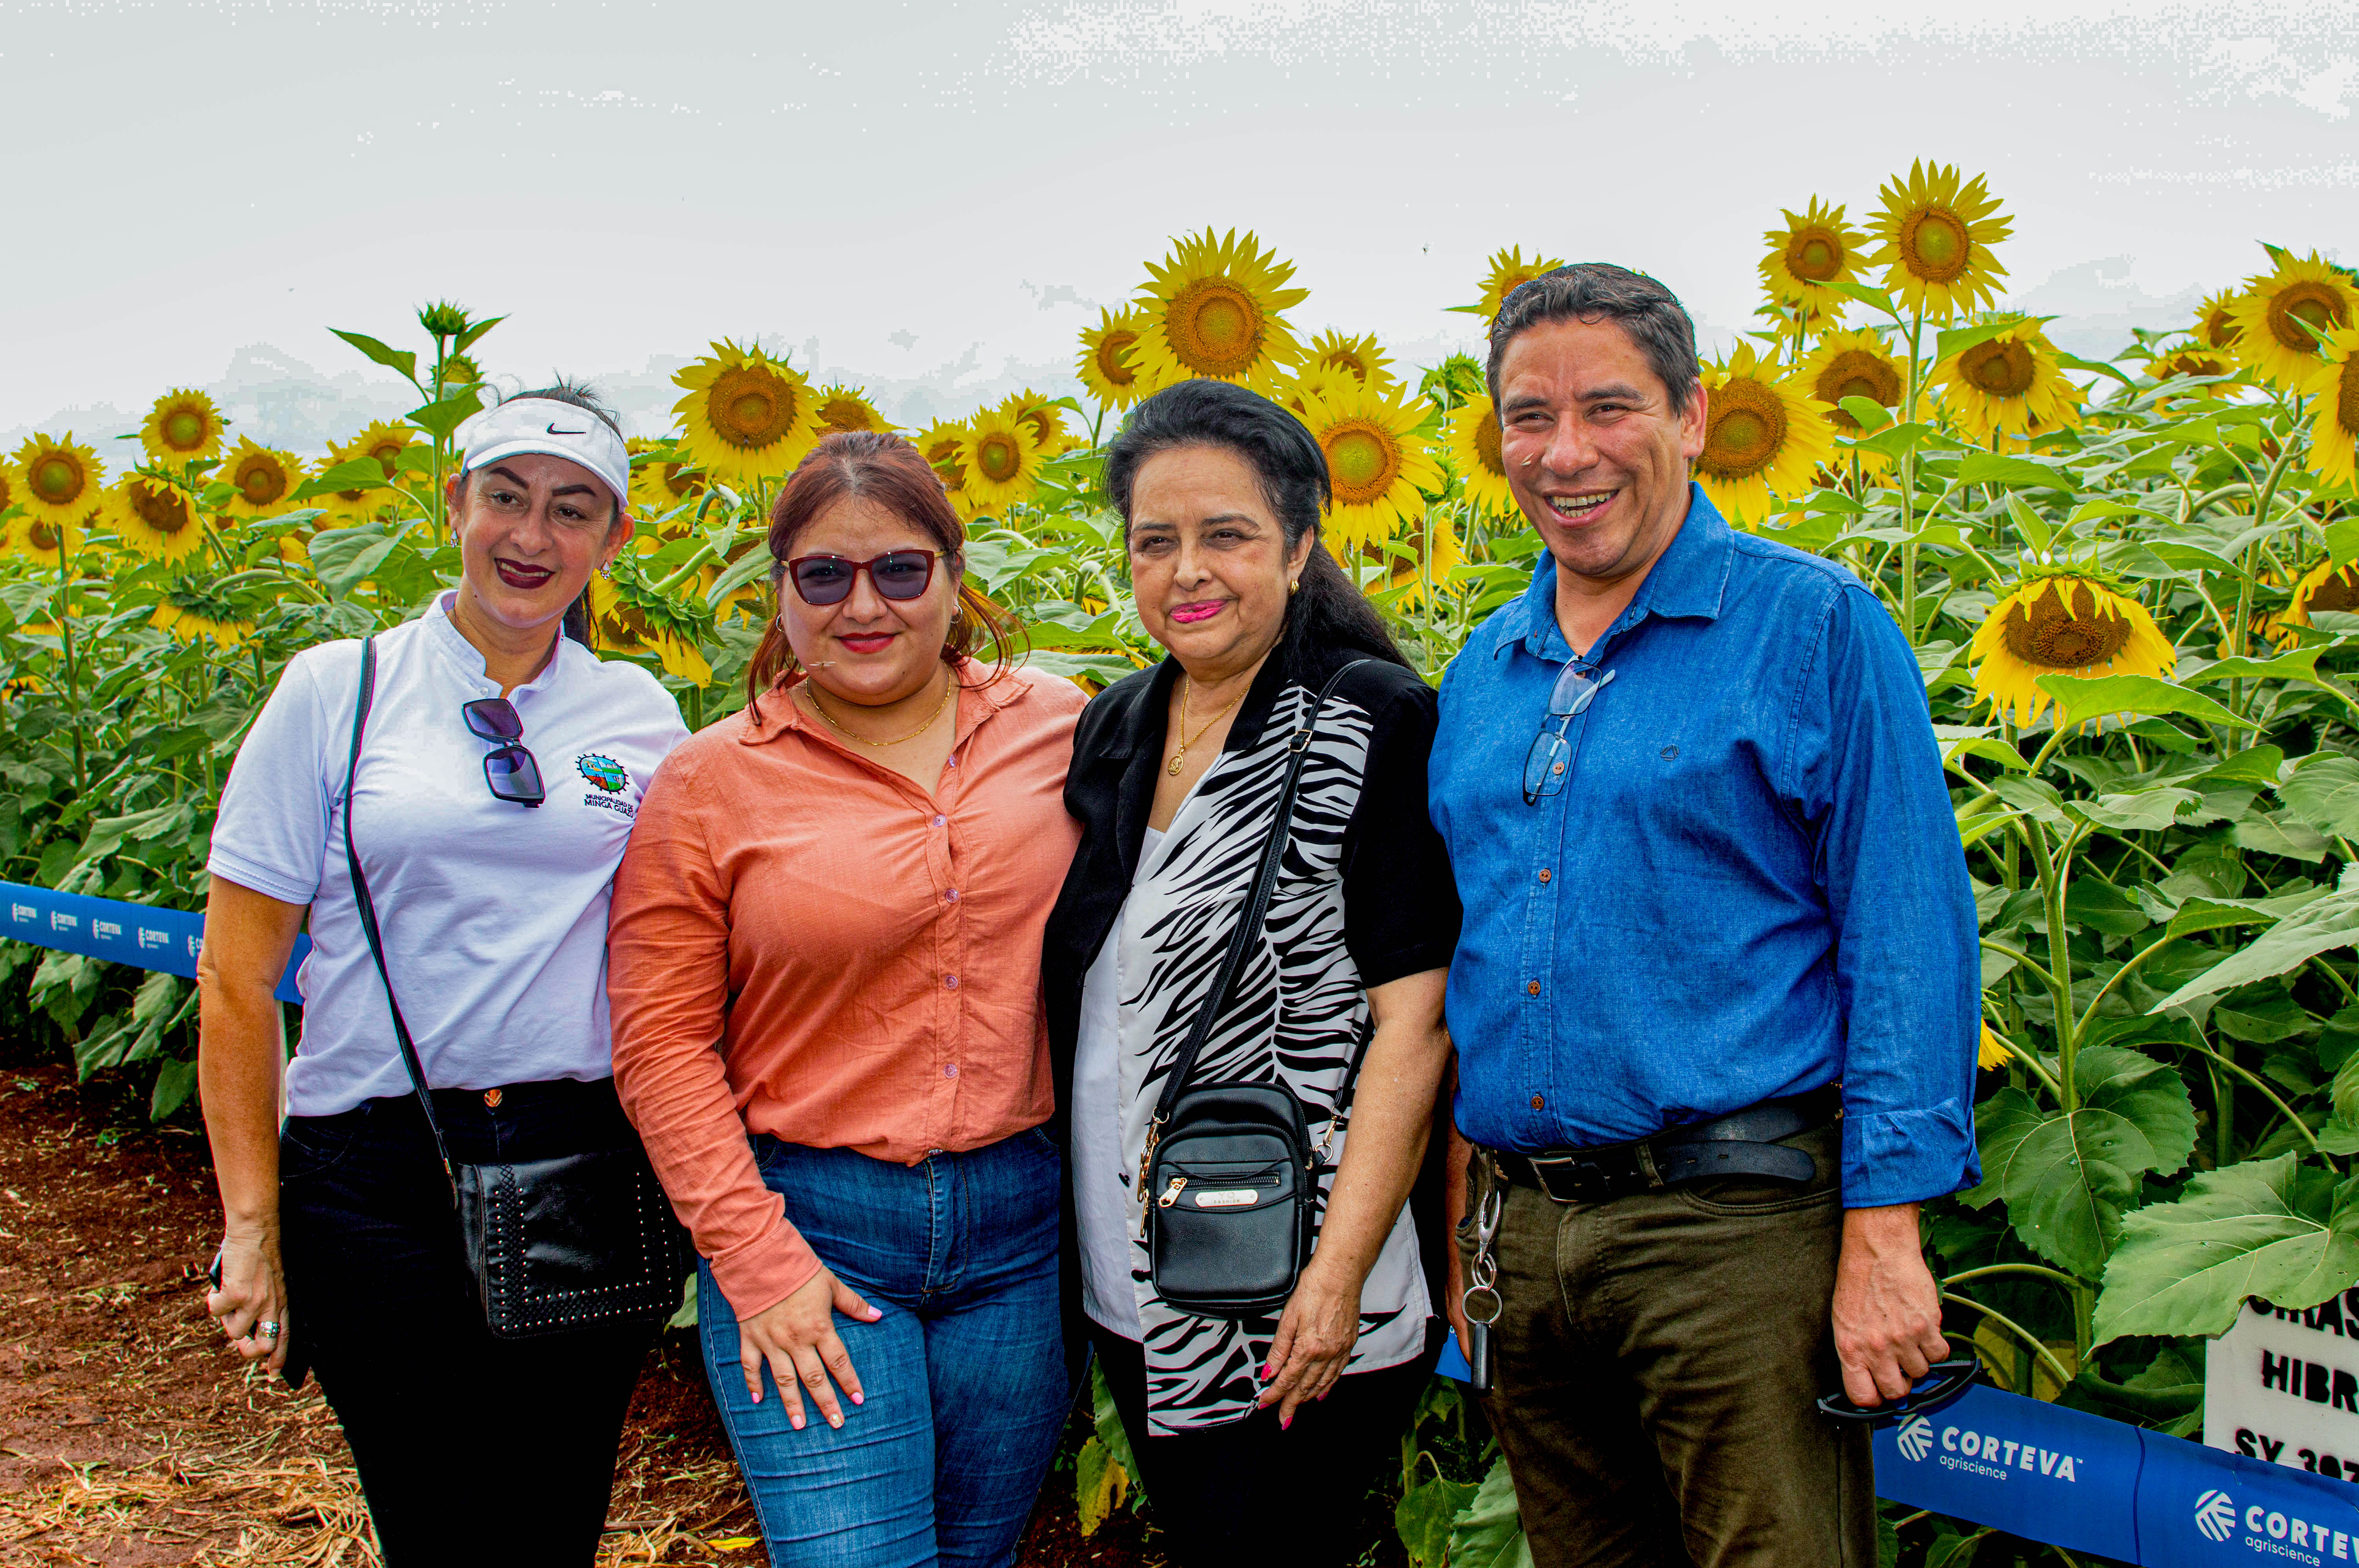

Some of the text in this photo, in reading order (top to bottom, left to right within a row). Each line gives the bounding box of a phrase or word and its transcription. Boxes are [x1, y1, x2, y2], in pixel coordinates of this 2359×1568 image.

[584, 799, 612, 809] MINGA
[585, 794, 627, 807] MUNICIPALIDAD
[145, 929, 169, 944] CORTEVA
[1942, 1426, 2076, 1483] CORTEVA
[2235, 1428, 2285, 1463] SY
[1939, 1454, 2007, 1480] agriscience
[2245, 1536, 2321, 1567] agriscience
